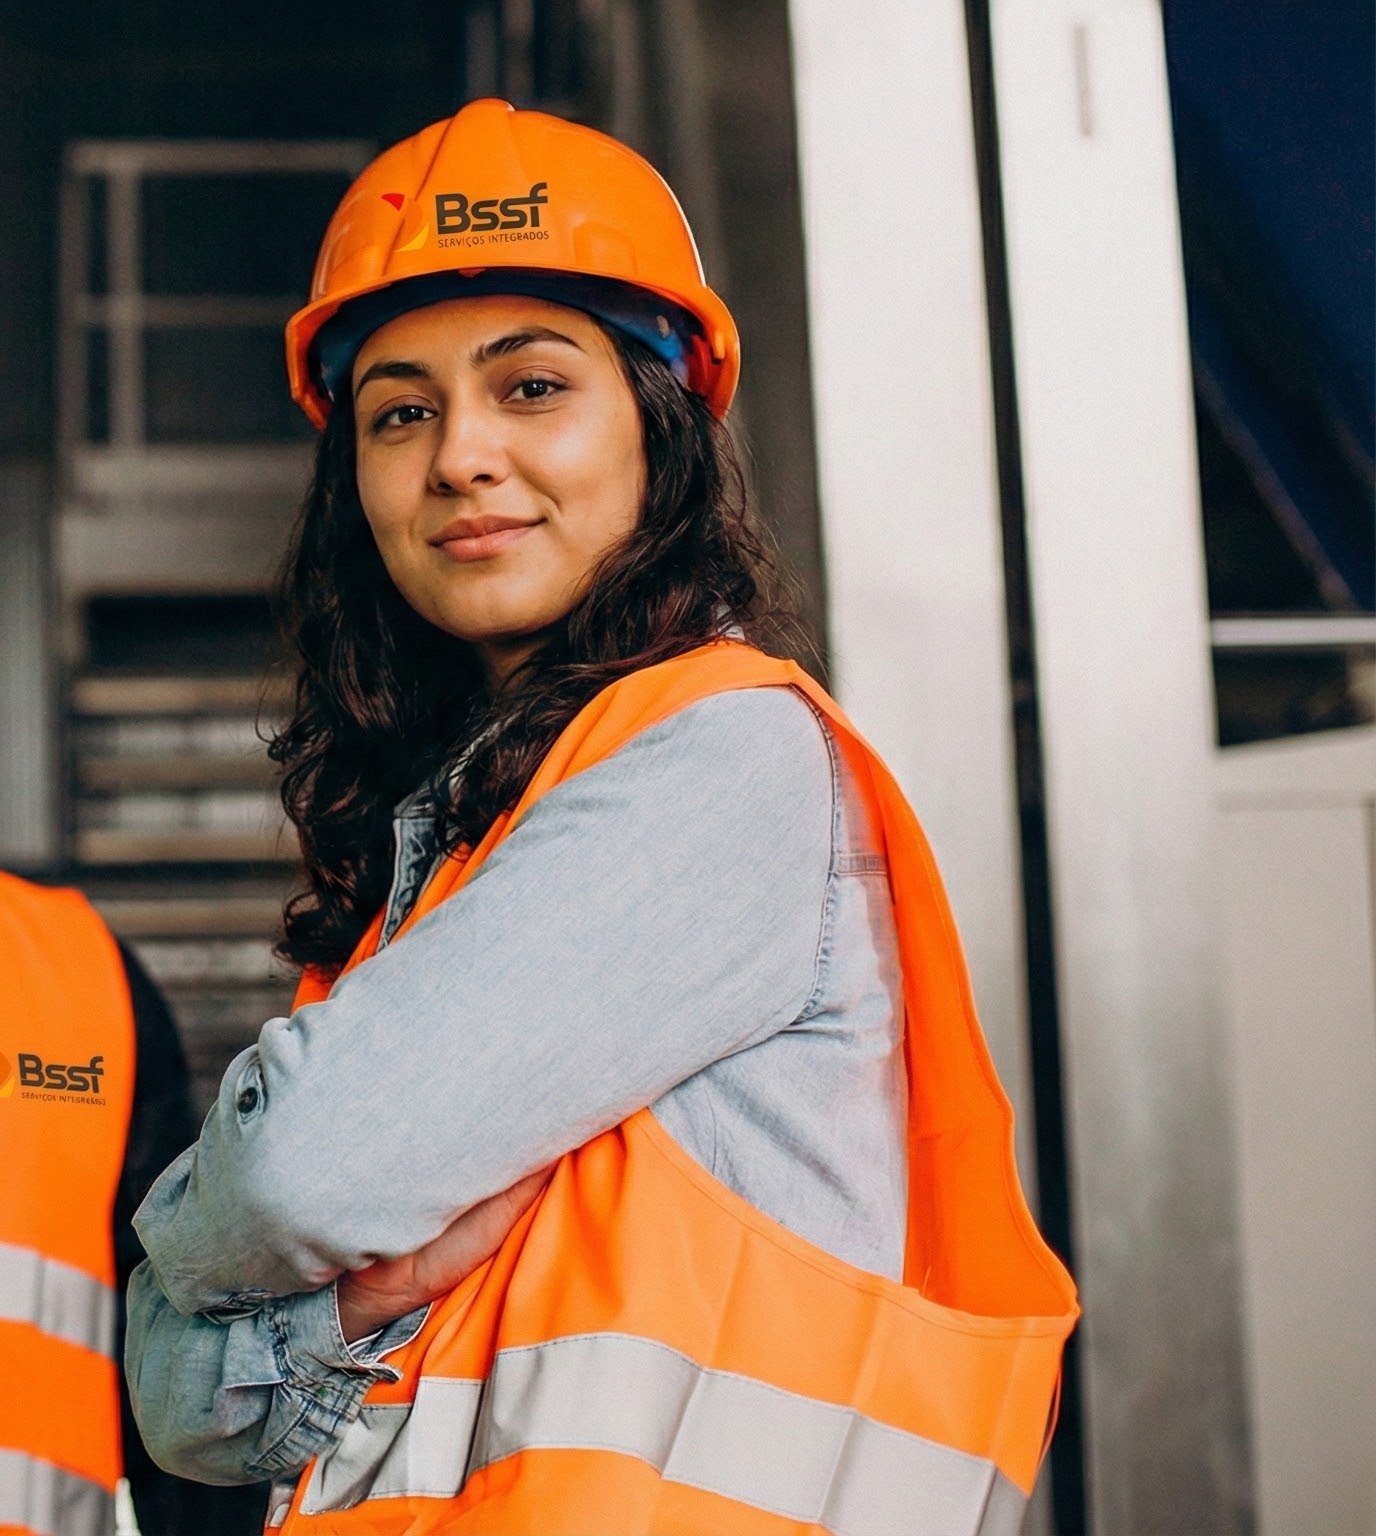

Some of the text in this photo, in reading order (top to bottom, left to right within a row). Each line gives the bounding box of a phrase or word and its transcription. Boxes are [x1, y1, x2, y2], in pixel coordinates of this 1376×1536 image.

[435, 182, 548, 235] Bssf
[438, 230, 550, 248] SERVIÇOS INTEGRADOS
[18, 1053, 104, 1094] Bssf
